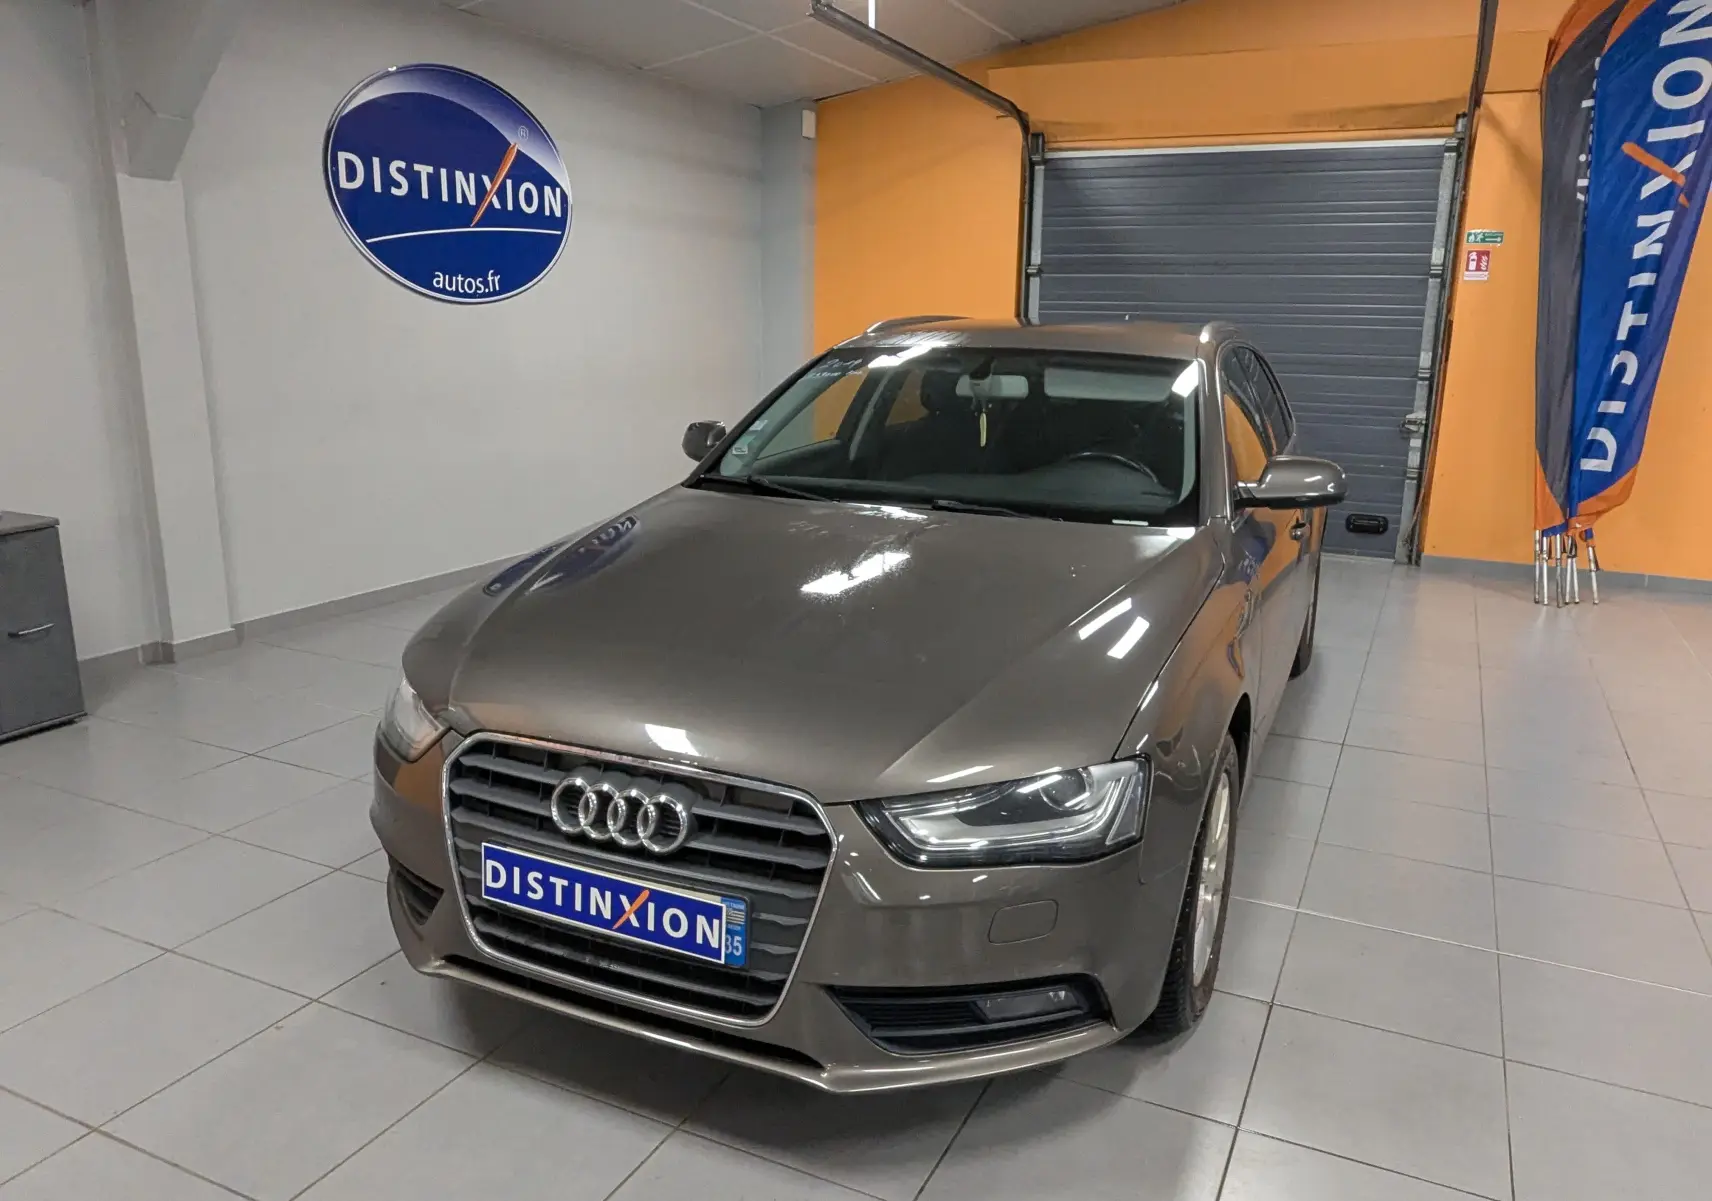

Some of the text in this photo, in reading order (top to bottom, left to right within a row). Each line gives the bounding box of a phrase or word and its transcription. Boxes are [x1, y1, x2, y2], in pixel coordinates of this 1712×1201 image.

[337, 144, 562, 227] DISTINXION
[432, 270, 500, 293] autos.fr
[485, 859, 720, 949] DISTINXION
